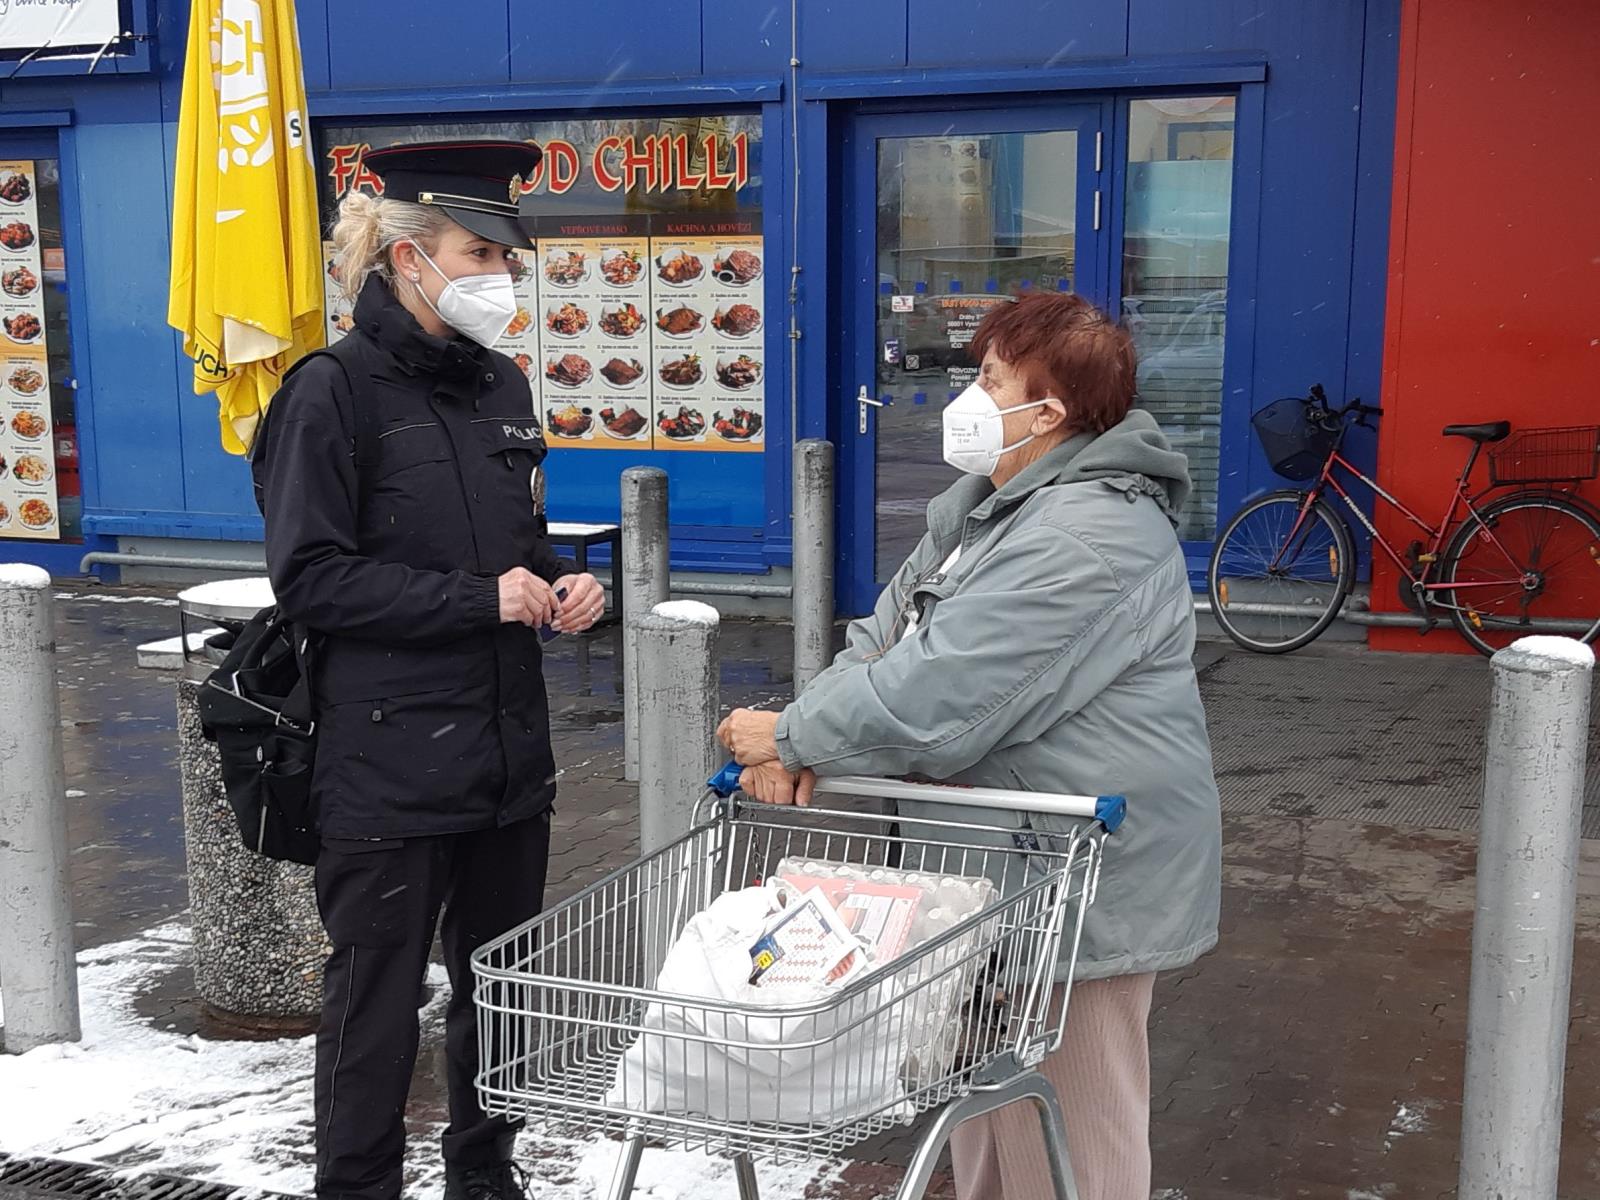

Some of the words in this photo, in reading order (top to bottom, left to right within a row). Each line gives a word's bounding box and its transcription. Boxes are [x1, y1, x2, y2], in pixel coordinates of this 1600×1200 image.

[289, 118, 302, 138] S
[591, 130, 749, 194] CHILLI
[667, 223, 705, 233] KACHNA
[502, 424, 544, 441] POLIC
